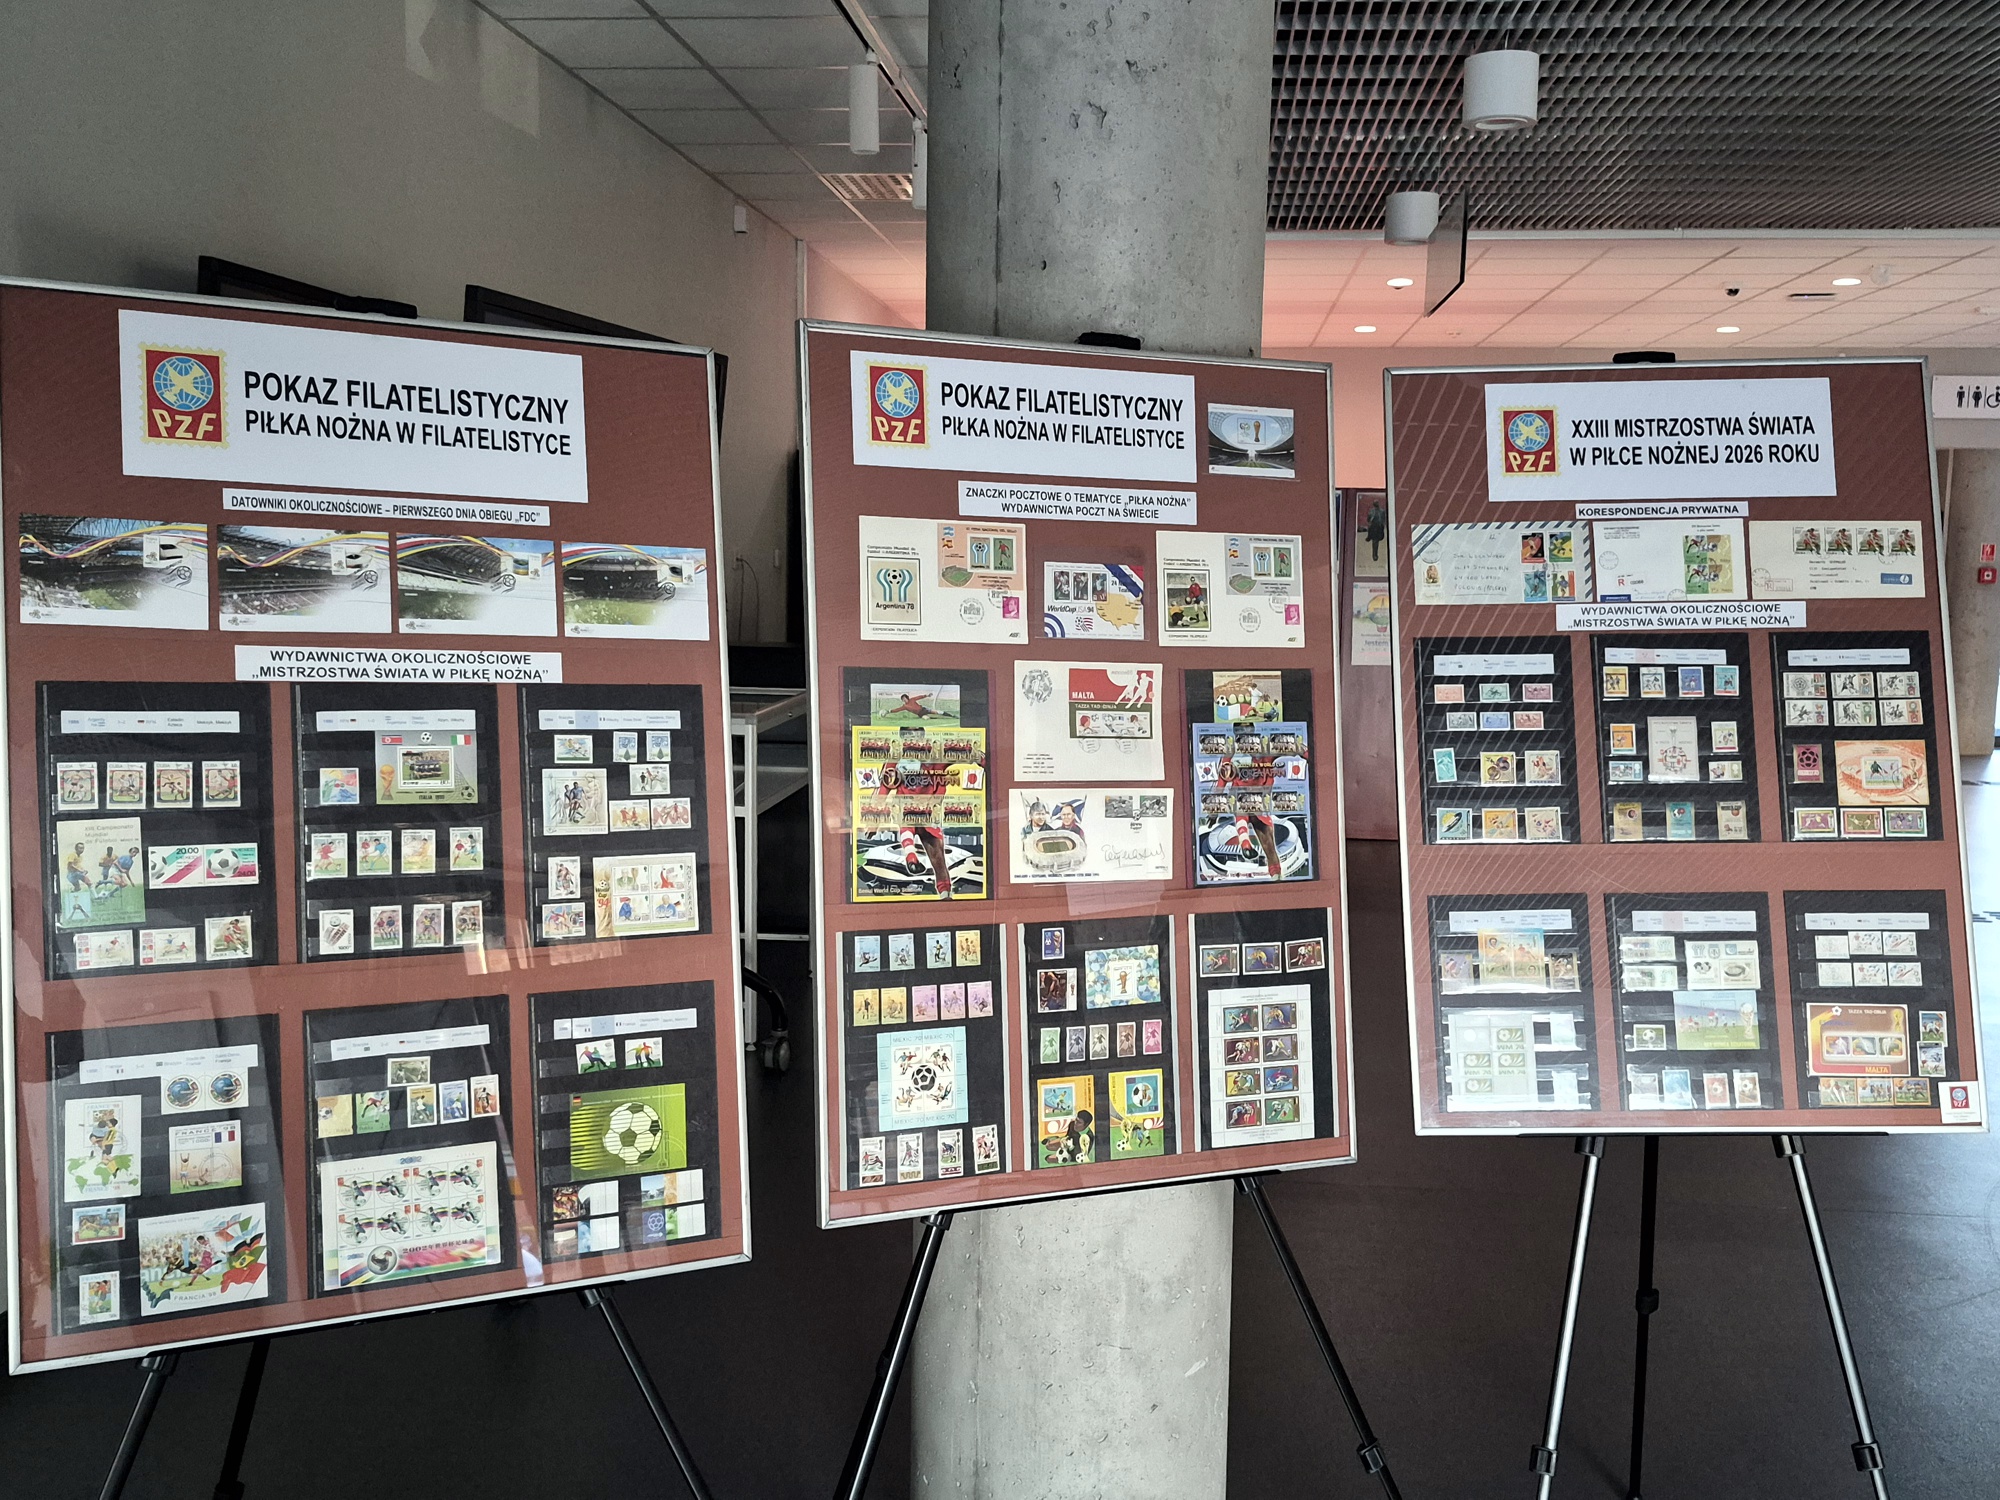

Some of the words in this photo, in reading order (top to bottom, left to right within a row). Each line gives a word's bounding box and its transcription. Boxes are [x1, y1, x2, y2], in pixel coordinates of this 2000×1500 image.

[244, 370, 339, 406] POKAZ
[346, 379, 569, 425] FILATELISTYCZNY
[941, 382, 1011, 410] POKAZ
[1016, 387, 1184, 422] FILATELISTYCZNY
[152, 408, 217, 441] PZF
[246, 409, 311, 437] PIŁKA
[316, 411, 392, 443] NOŻNA
[396, 421, 416, 444] W
[422, 423, 572, 456] FILATELISTYCE
[873, 415, 923, 442] PZF
[942, 415, 990, 438] PIŁKA
[994, 416, 1049, 442] NOŻNA
[1052, 422, 1067, 443] W
[1071, 424, 1185, 450] FILATELISTYCE
[1571, 419, 1609, 438] XXIII
[1615, 416, 1745, 438] MISTRZOSTWA
[1748, 411, 1815, 436] ŚWIATA
[1508, 450, 1552, 472] PZF
[1570, 447, 1587, 466] W
[1592, 446, 1643, 466] PIŁCE
[1648, 441, 1719, 464] NOŻNEJ
[1724, 444, 1764, 464] 2026
[1768, 443, 1820, 463] ROKU
[965, 487, 1007, 500] ZNACZKI
[1009, 490, 1062, 502] POCZTOWE
[1064, 492, 1072, 502] O
[1074, 492, 1122, 505] TEMATYCE
[231, 495, 287, 510] DATOWNIKI
[289, 499, 383, 515] OKOLICZNOŚCIOWE
[392, 504, 453, 518] PIERWSZEGO
[455, 507, 477, 519] DNIA
[478, 509, 513, 521] OBIEGU
[1001, 502, 1074, 516] WYDAWNICTWA
[1075, 506, 1106, 517] POCZT
[1107, 507, 1121, 517] NA
[1123, 505, 1159, 519] ŚWIECIE
[1578, 506, 1679, 517] KORESPONDENCJA
[1681, 505, 1739, 515] PRYWATNA
[1617, 578, 1625, 586] R
[876, 602, 905, 611] Argentina
[1580, 605, 1668, 616] WYDAWNICTWA
[1670, 602, 1781, 615] OKOLICZNOŚCIOWE
[1657, 615, 1697, 627] ŚWIATA
[1701, 617, 1713, 626] W
[1715, 616, 1748, 628] PIŁKĘ
[270, 650, 388, 663] WYDAWNICTWA
[391, 650, 532, 665] OKOLICZNOŚCIOWE
[374, 665, 429, 679] ŚWIATA
[432, 668, 446, 679] W
[450, 668, 490, 682] PIŁKĘ
[1072, 691, 1095, 699] MALTA
